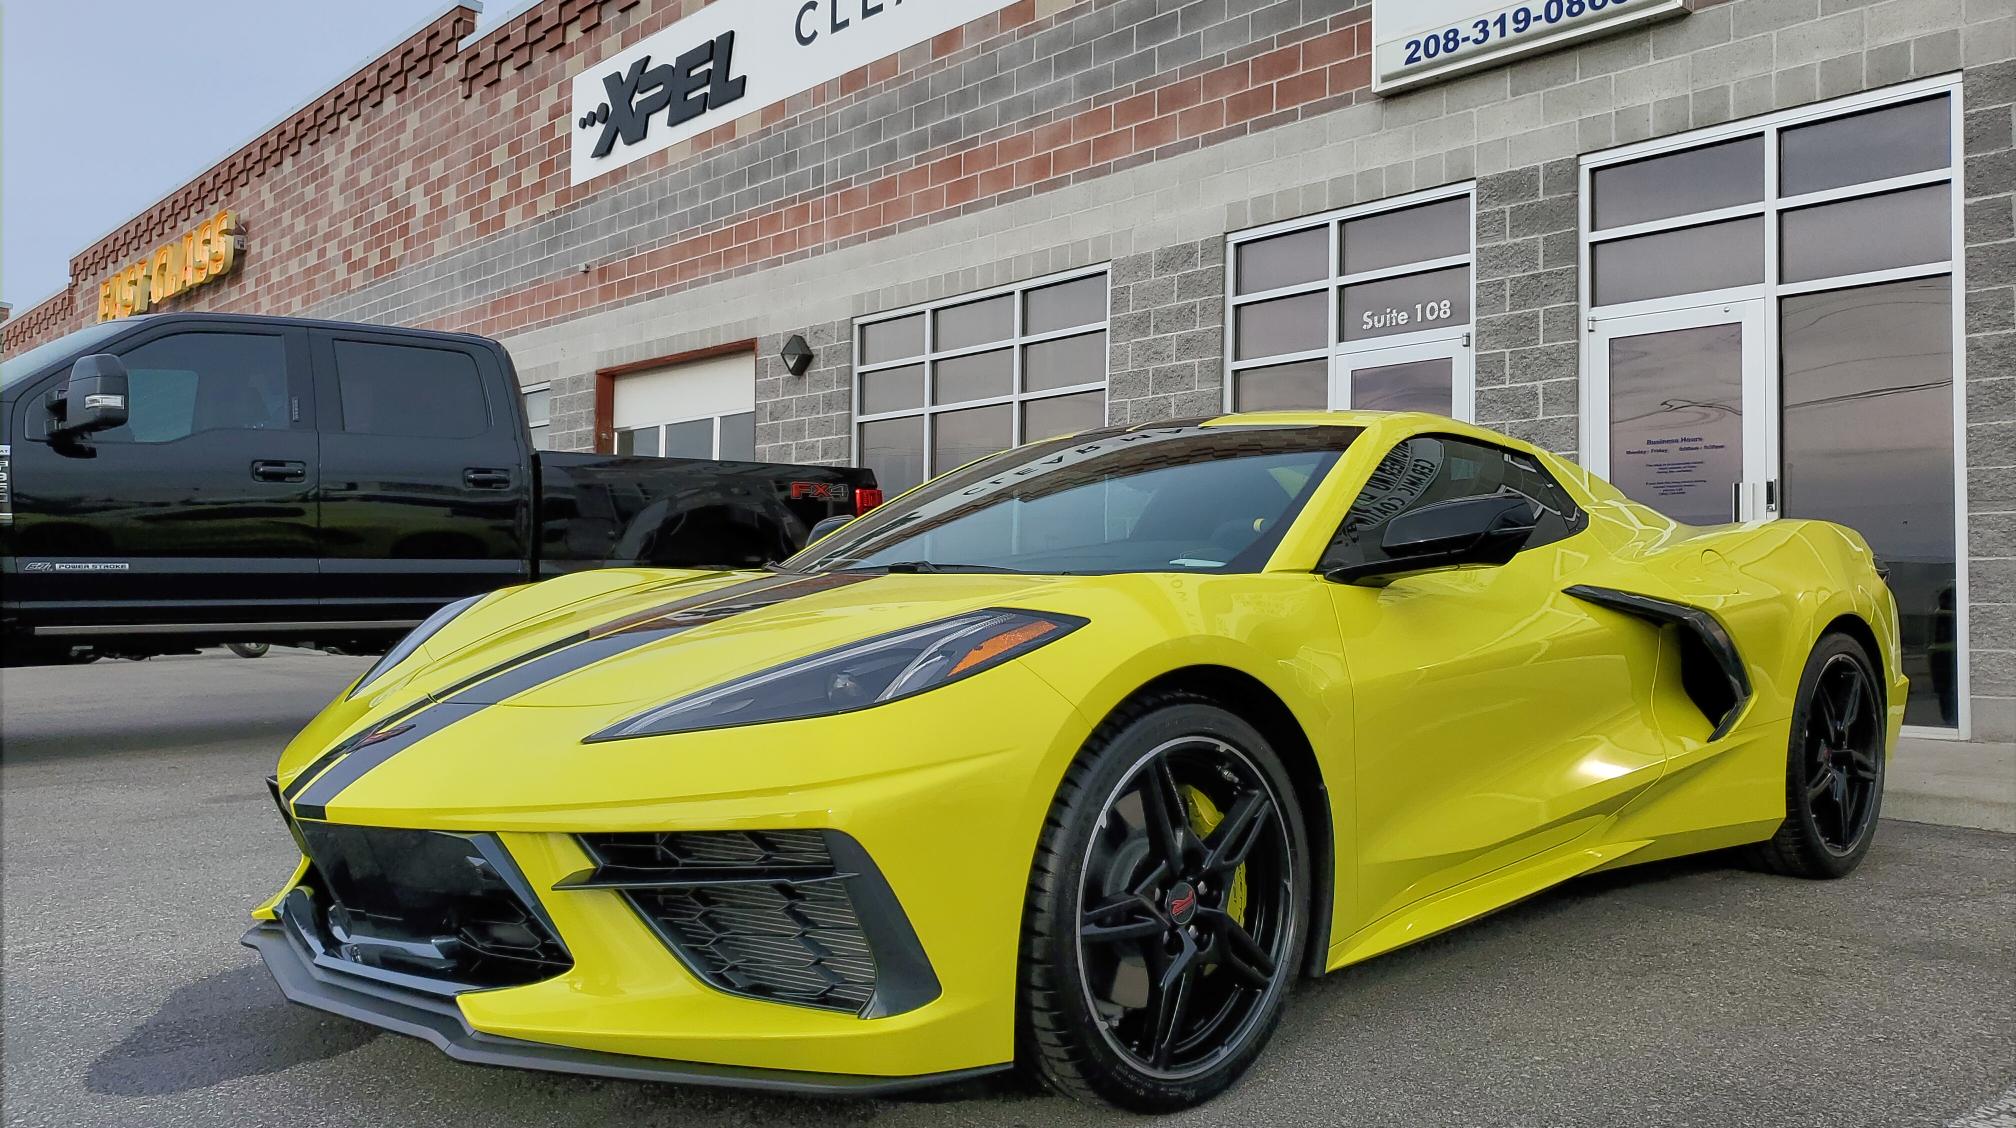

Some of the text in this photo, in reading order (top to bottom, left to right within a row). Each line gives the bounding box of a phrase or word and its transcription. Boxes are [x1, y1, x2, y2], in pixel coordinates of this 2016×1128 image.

[590, 30, 747, 159] XPEL
[1362, 299, 1451, 330] Suite 108
[790, 481, 849, 500] FX4
